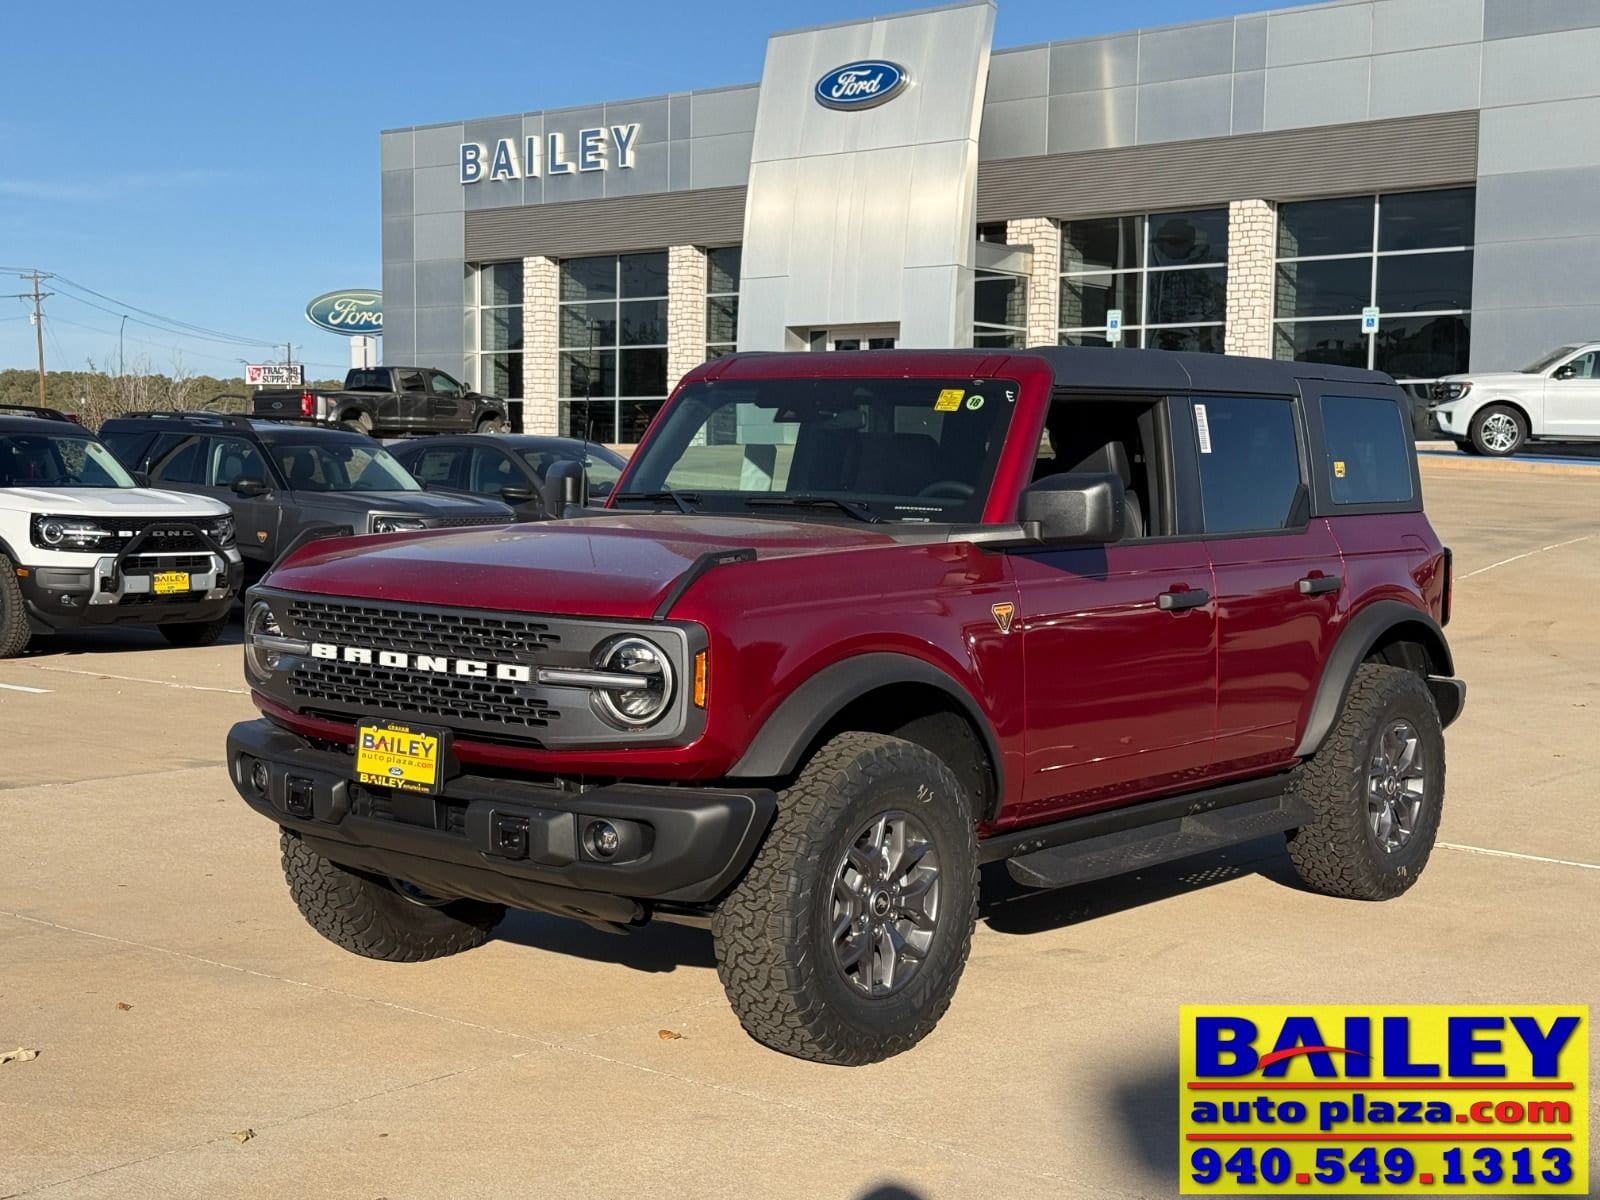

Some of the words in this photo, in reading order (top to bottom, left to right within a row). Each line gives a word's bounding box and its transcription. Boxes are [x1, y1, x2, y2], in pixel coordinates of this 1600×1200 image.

[831, 69, 884, 97] Ford
[459, 122, 641, 185] BAILEY
[154, 574, 187, 583] BAILEY
[311, 642, 530, 682] BRONCO
[363, 733, 434, 758] BAILEY
[360, 773, 405, 789] BAILEY
